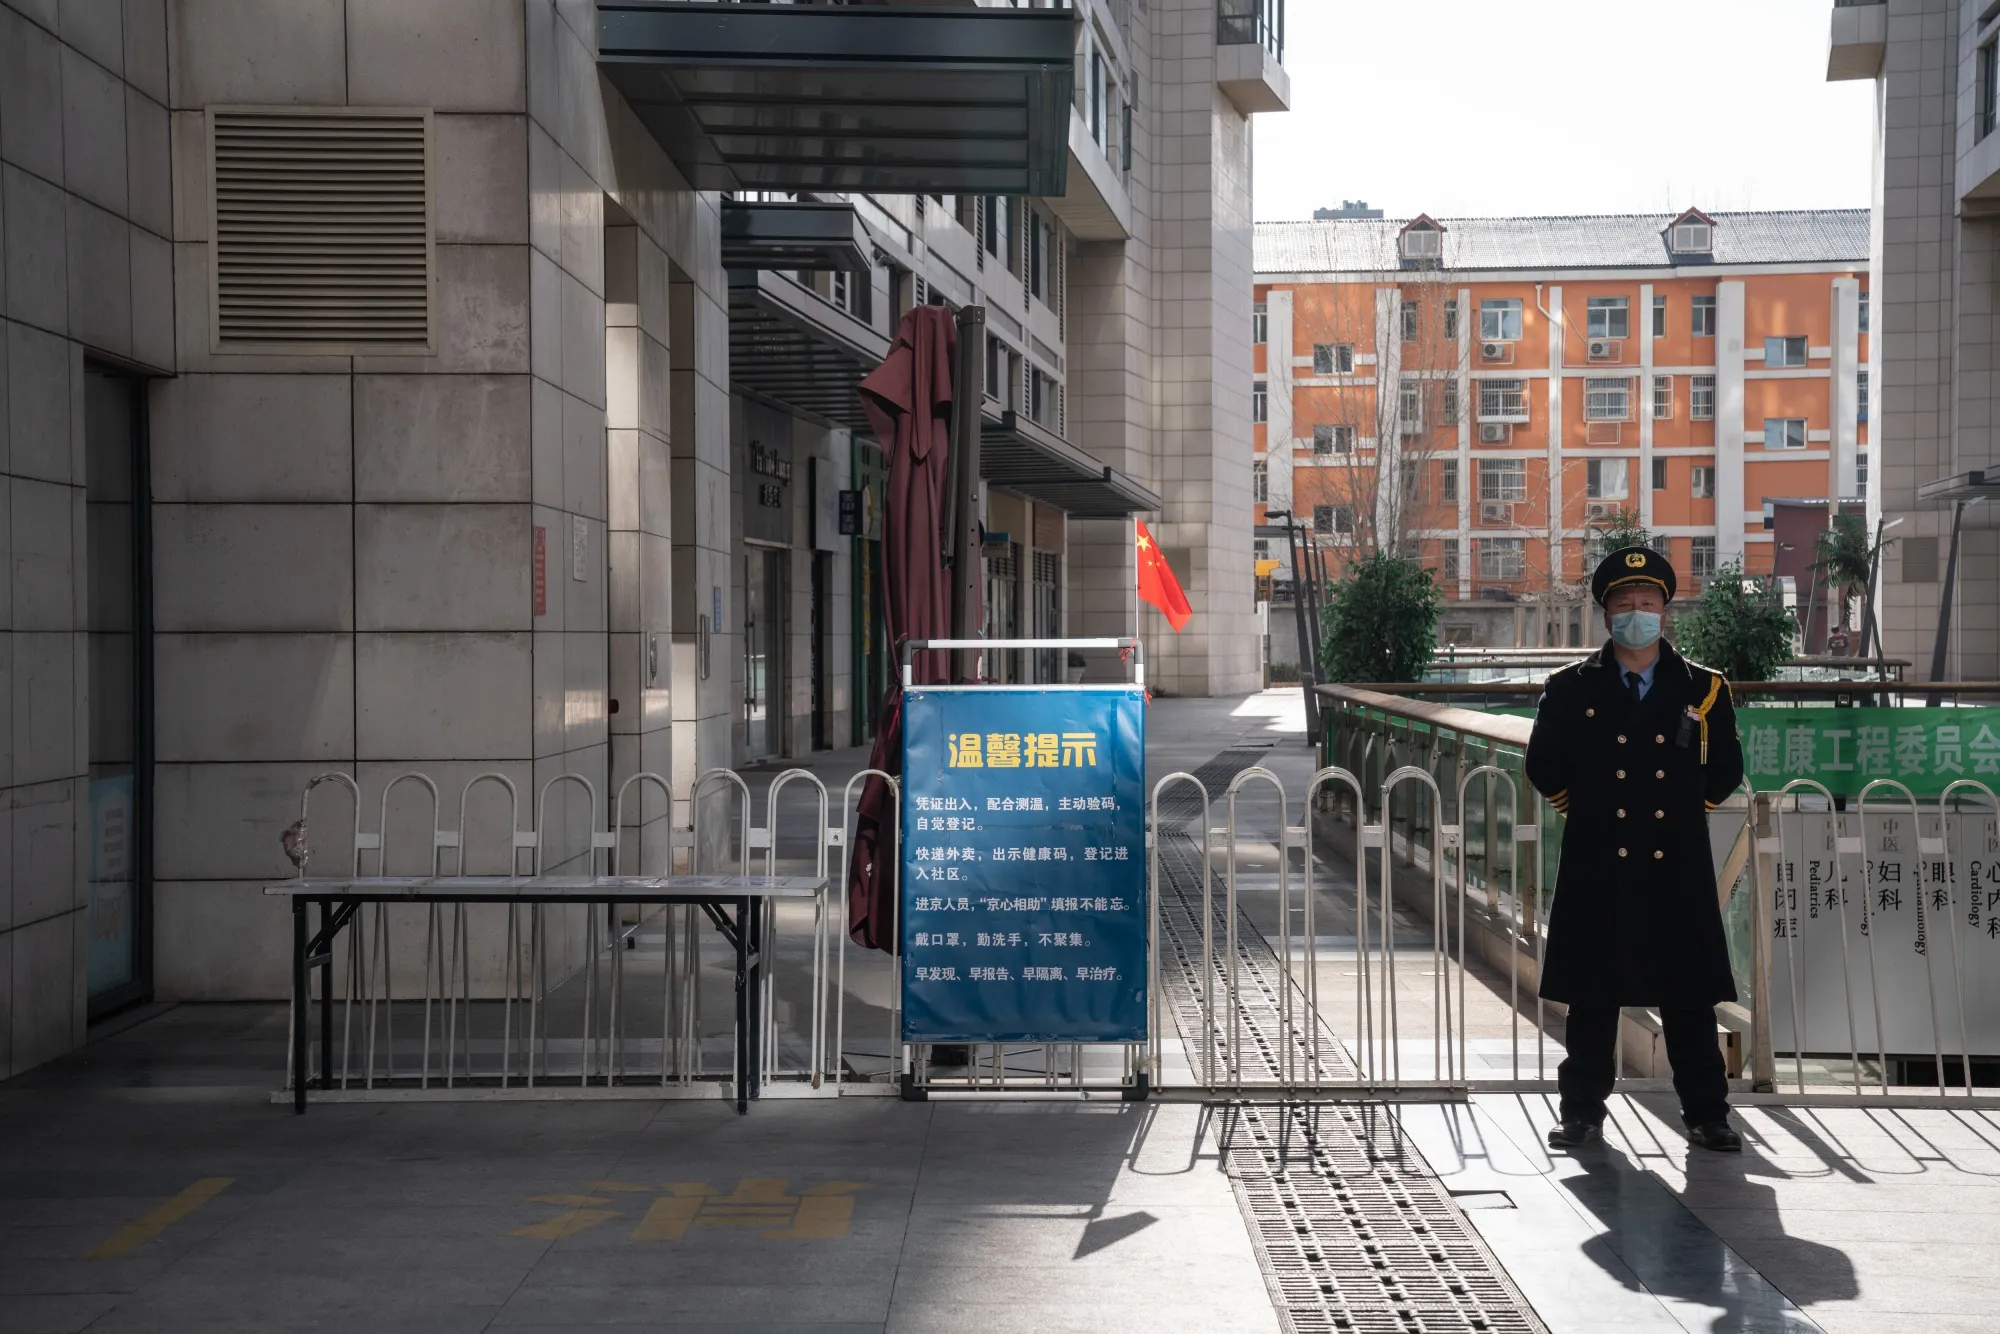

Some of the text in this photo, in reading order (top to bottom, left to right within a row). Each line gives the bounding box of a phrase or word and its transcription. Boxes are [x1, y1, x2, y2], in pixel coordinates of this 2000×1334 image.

[949, 732, 1097, 768] 温馨提示
[1738, 724, 2000, 776] 健康工程委员会
[916, 817, 983, 831] 自觉登记。
[1882, 818, 1900, 852] 中医
[915, 846, 1129, 861] 快递外卖，出示健康码，登记进
[915, 867, 968, 881] 入社区。
[1809, 860, 1821, 919] Pediatrics
[1878, 860, 1902, 911] 妇科
[1968, 860, 1983, 929] Cardiology
[915, 932, 1091, 947] 戴口罩，勤洗手，不聚集。
[915, 966, 1123, 981] 早发现、早报告、早隔离、早治疗。
